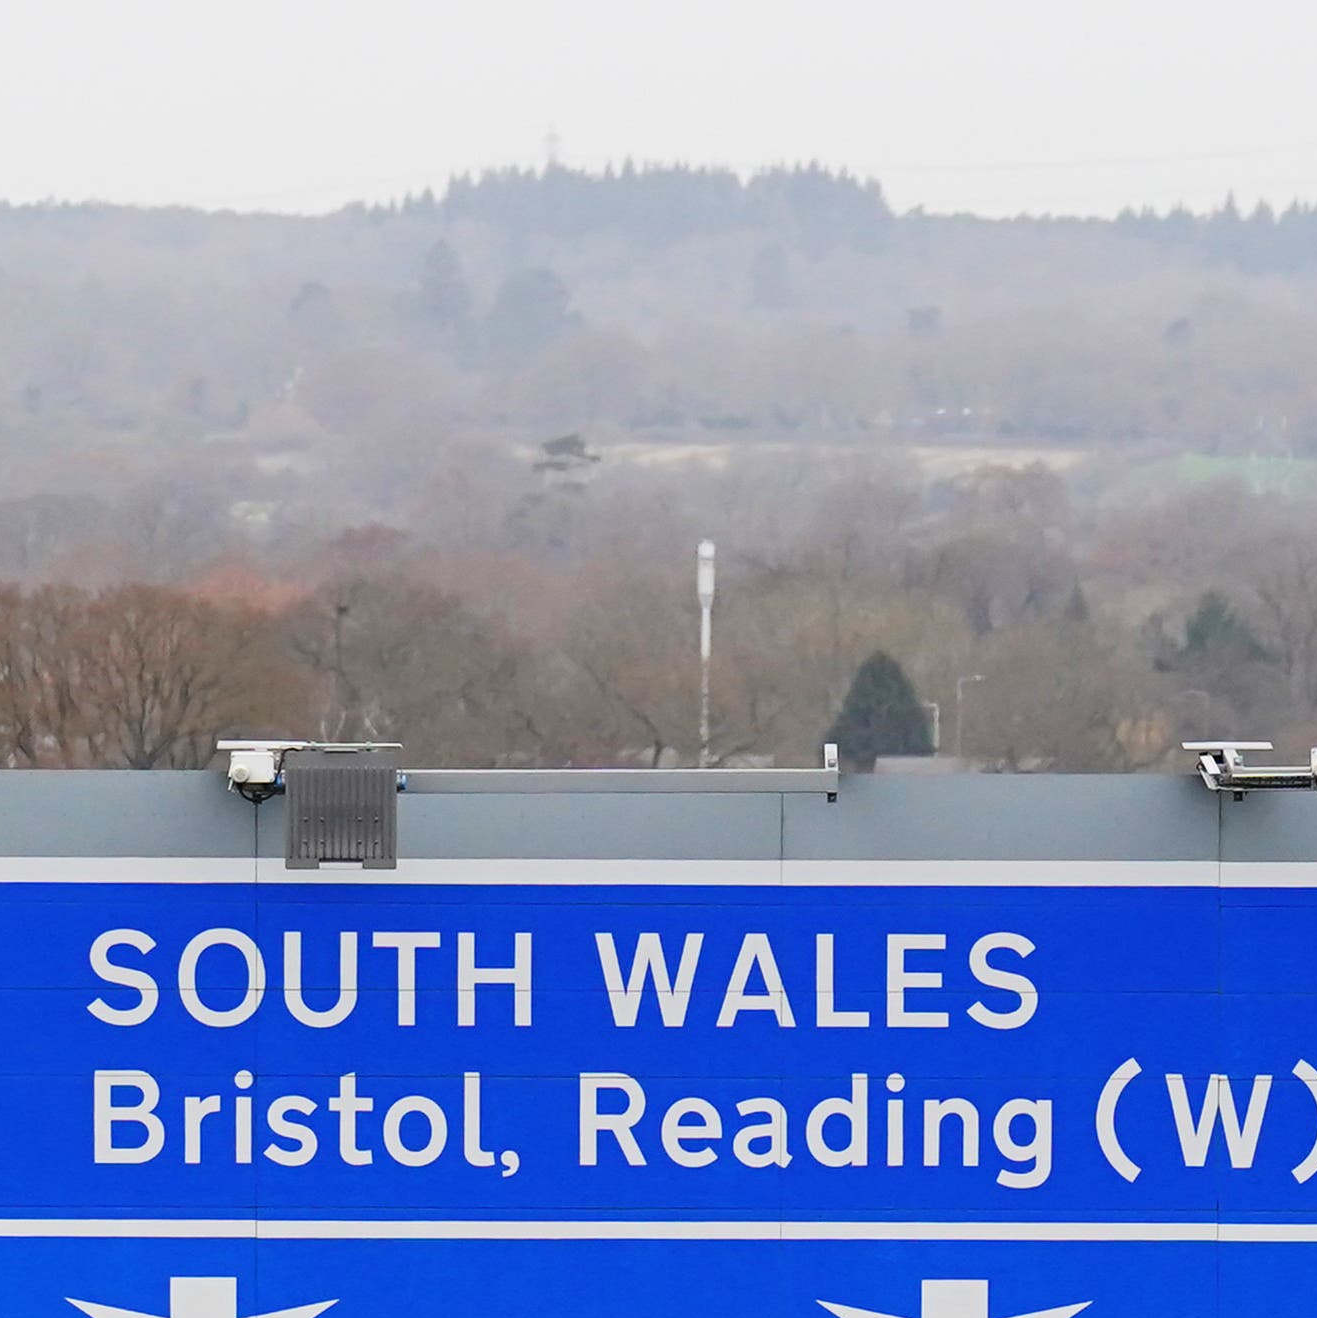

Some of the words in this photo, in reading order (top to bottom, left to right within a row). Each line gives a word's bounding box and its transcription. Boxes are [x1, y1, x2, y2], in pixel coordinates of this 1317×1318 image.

[86, 928, 532, 1028] SOUTH
[594, 931, 1038, 1030] WALES
[93, 1069, 520, 1177] Bristol,
[579, 1072, 1053, 1189] Reading
